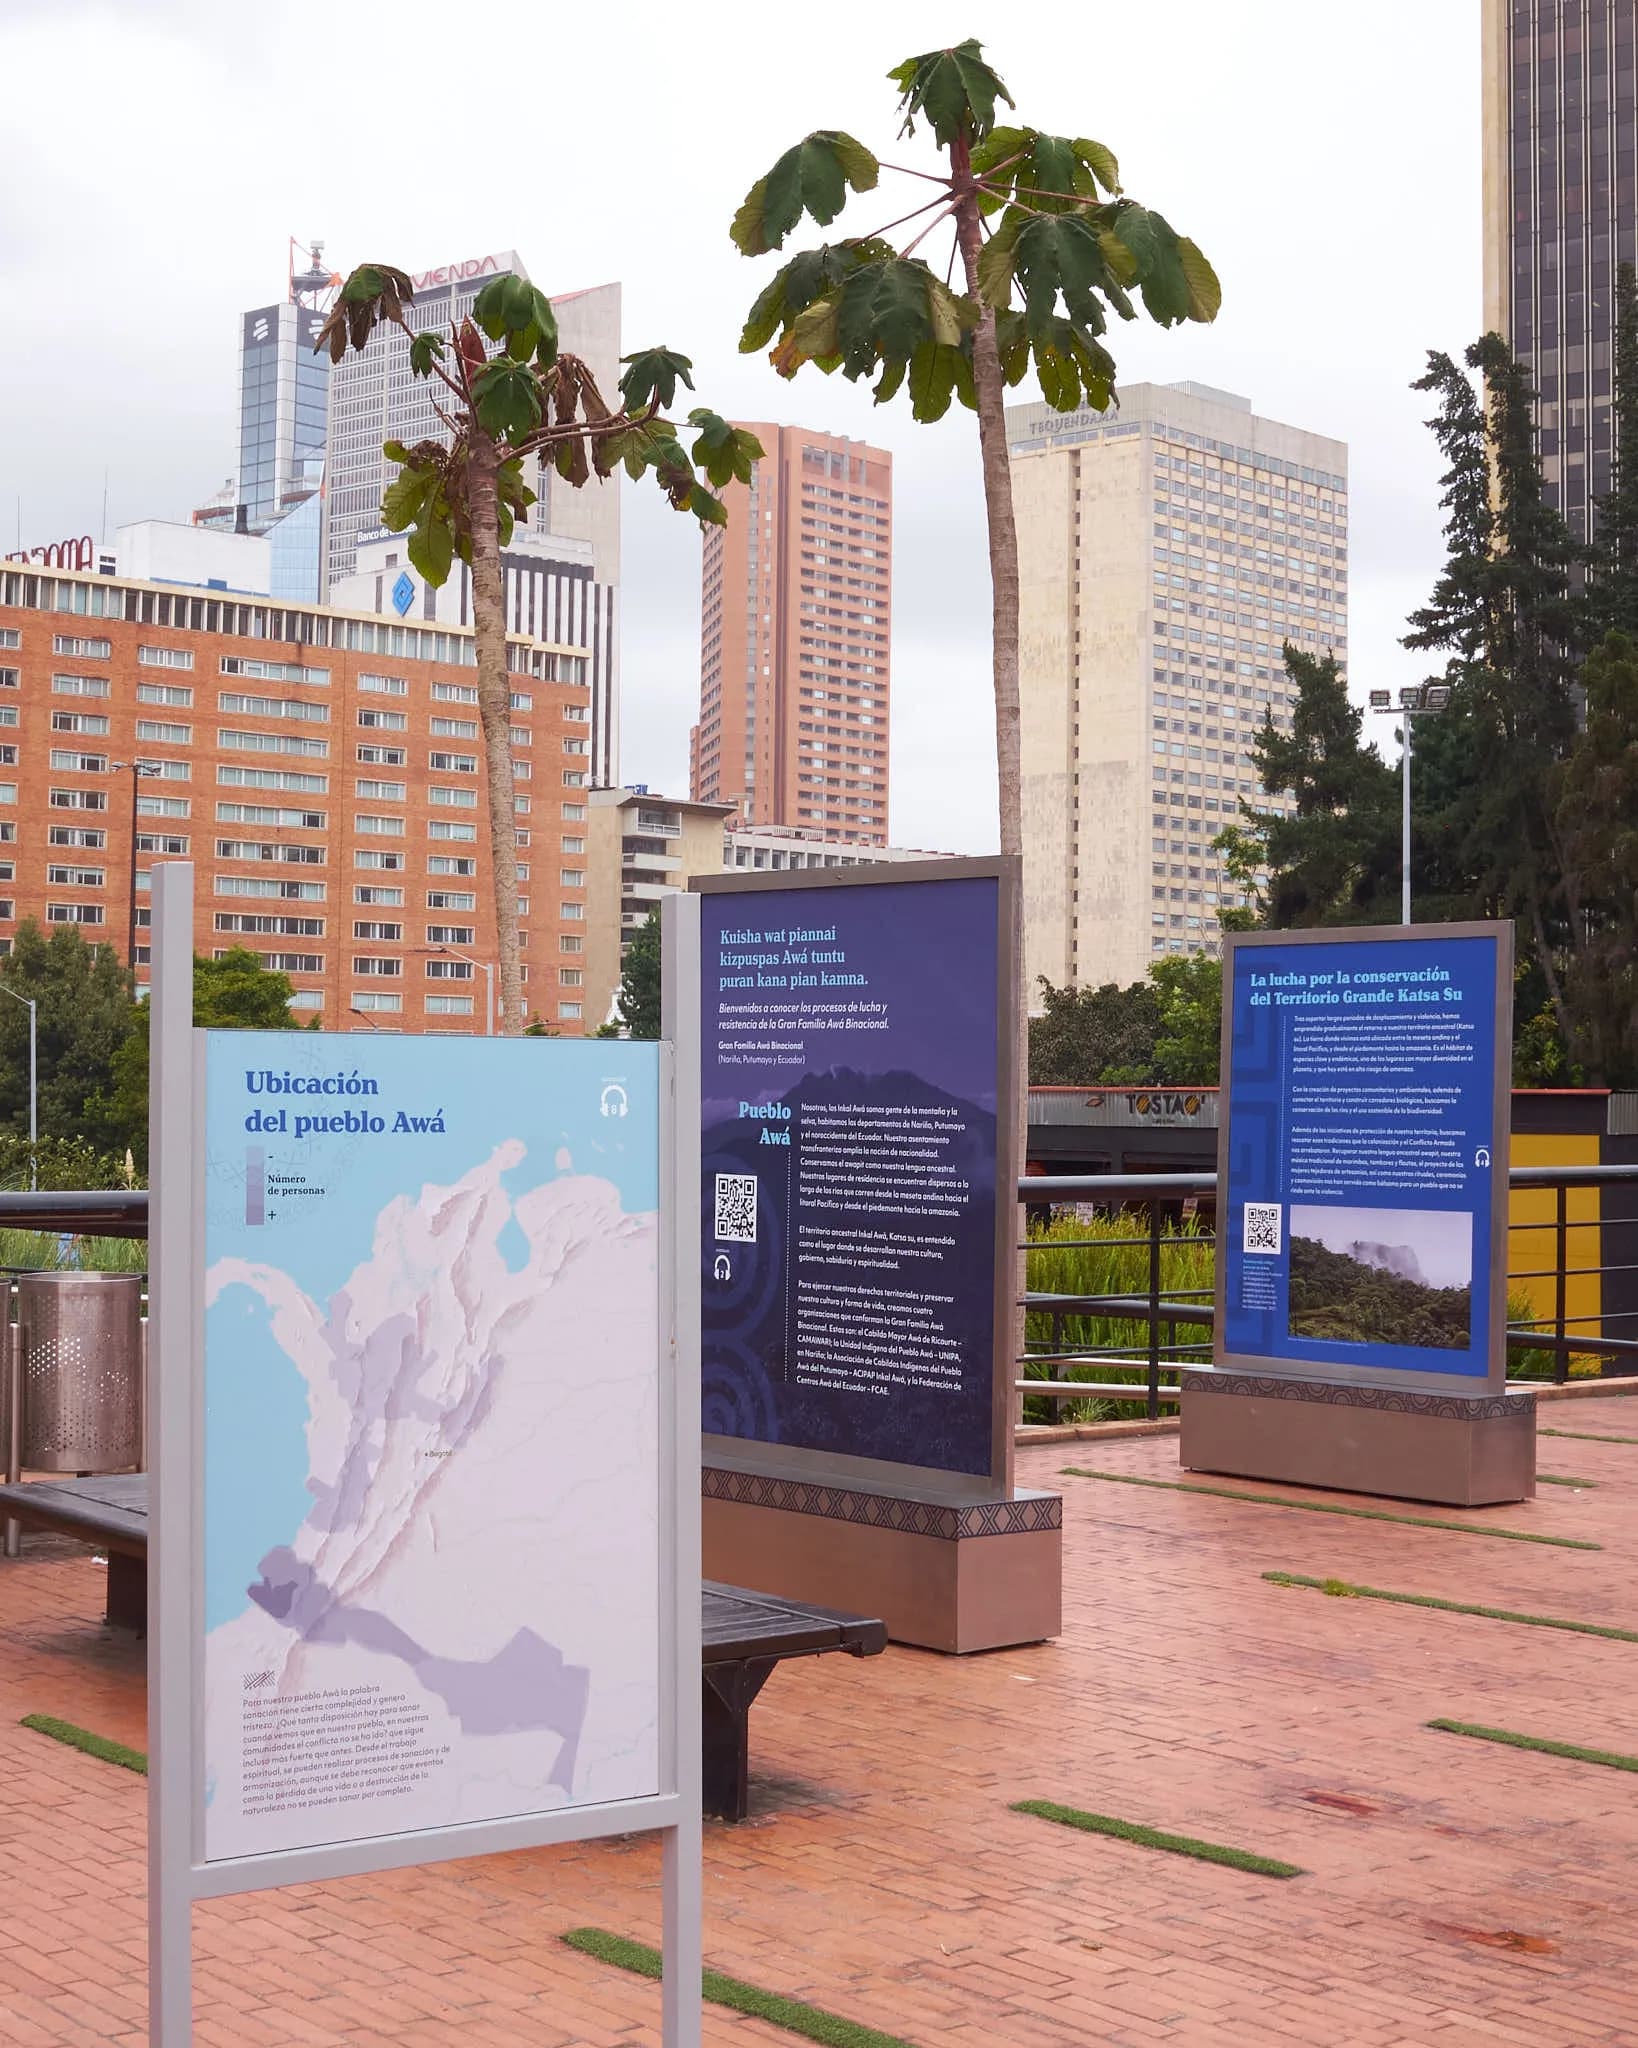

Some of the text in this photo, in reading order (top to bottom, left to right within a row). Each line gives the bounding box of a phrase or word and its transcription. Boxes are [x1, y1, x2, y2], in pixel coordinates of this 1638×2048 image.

[411, 255, 499, 289] VIENDA
[1030, 410, 1118, 434] TEQUENDAMA
[358, 530, 379, 542] Banco
[380, 527, 389, 537] de
[721, 926, 836, 945] Kuisha wat piannai
[720, 948, 845, 969] kizpuspas Awá tuntu
[720, 971, 868, 991] puran kana pian kamna.
[1251, 967, 1450, 988] La lucha por la conservación
[1250, 987, 1462, 1005] del Territorio Grande Katsa Su
[719, 1001, 887, 1014] Bienvenidos a conocer los procesos de lucha y
[719, 1018, 889, 1029] resistencia de la Gran Familia Awá Binacional.
[719, 1041, 803, 1050] Gran Familia Awá Binacional
[743, 1055, 772, 1065] Putumayo
[774, 1058, 777, 1066] y
[778, 1055, 805, 1064] Ecuador)
[246, 1071, 379, 1094] Ubicación
[738, 1102, 791, 1119] Pueblo
[245, 1109, 446, 1138] del pueblo Awá
[759, 1126, 791, 1145] Awá
[268, 1174, 306, 1183] Número
[268, 1186, 325, 1197] de personas
